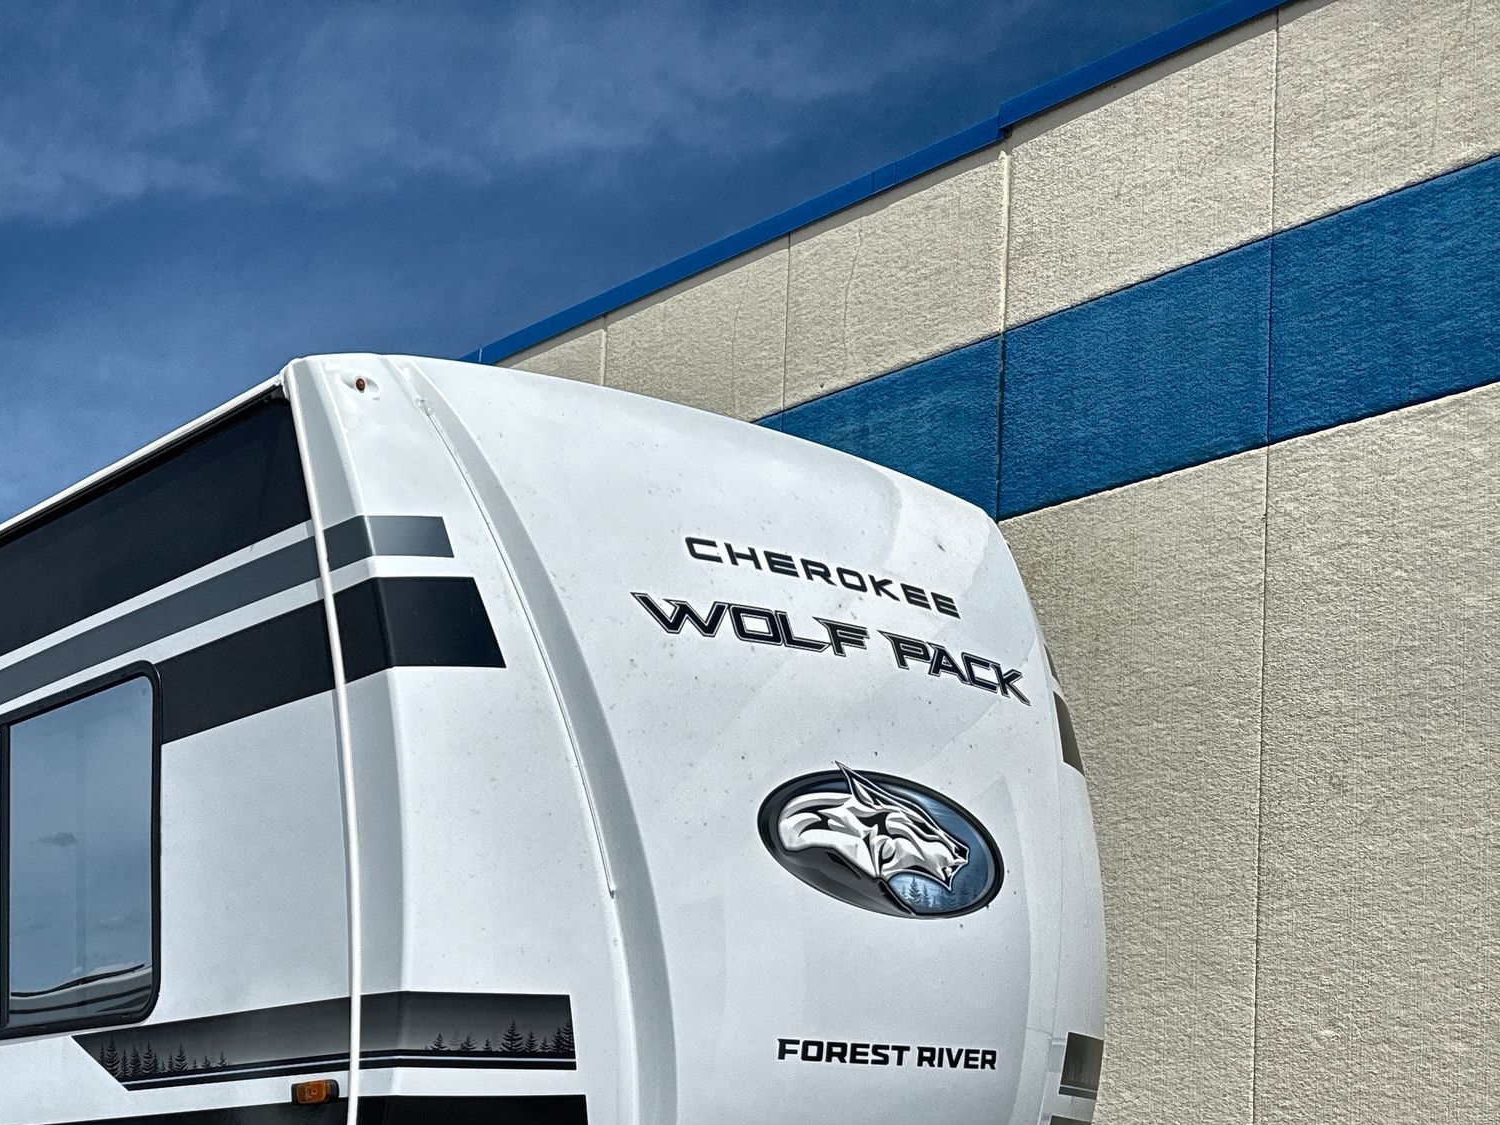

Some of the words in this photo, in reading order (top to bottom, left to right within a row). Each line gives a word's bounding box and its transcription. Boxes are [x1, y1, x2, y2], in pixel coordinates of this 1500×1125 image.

[685, 536, 961, 619] CHEROKEE
[630, 591, 870, 657] WOLF
[877, 629, 1031, 706] PACK
[777, 1038, 911, 1066] FOREST
[916, 1046, 997, 1070] RIVER
